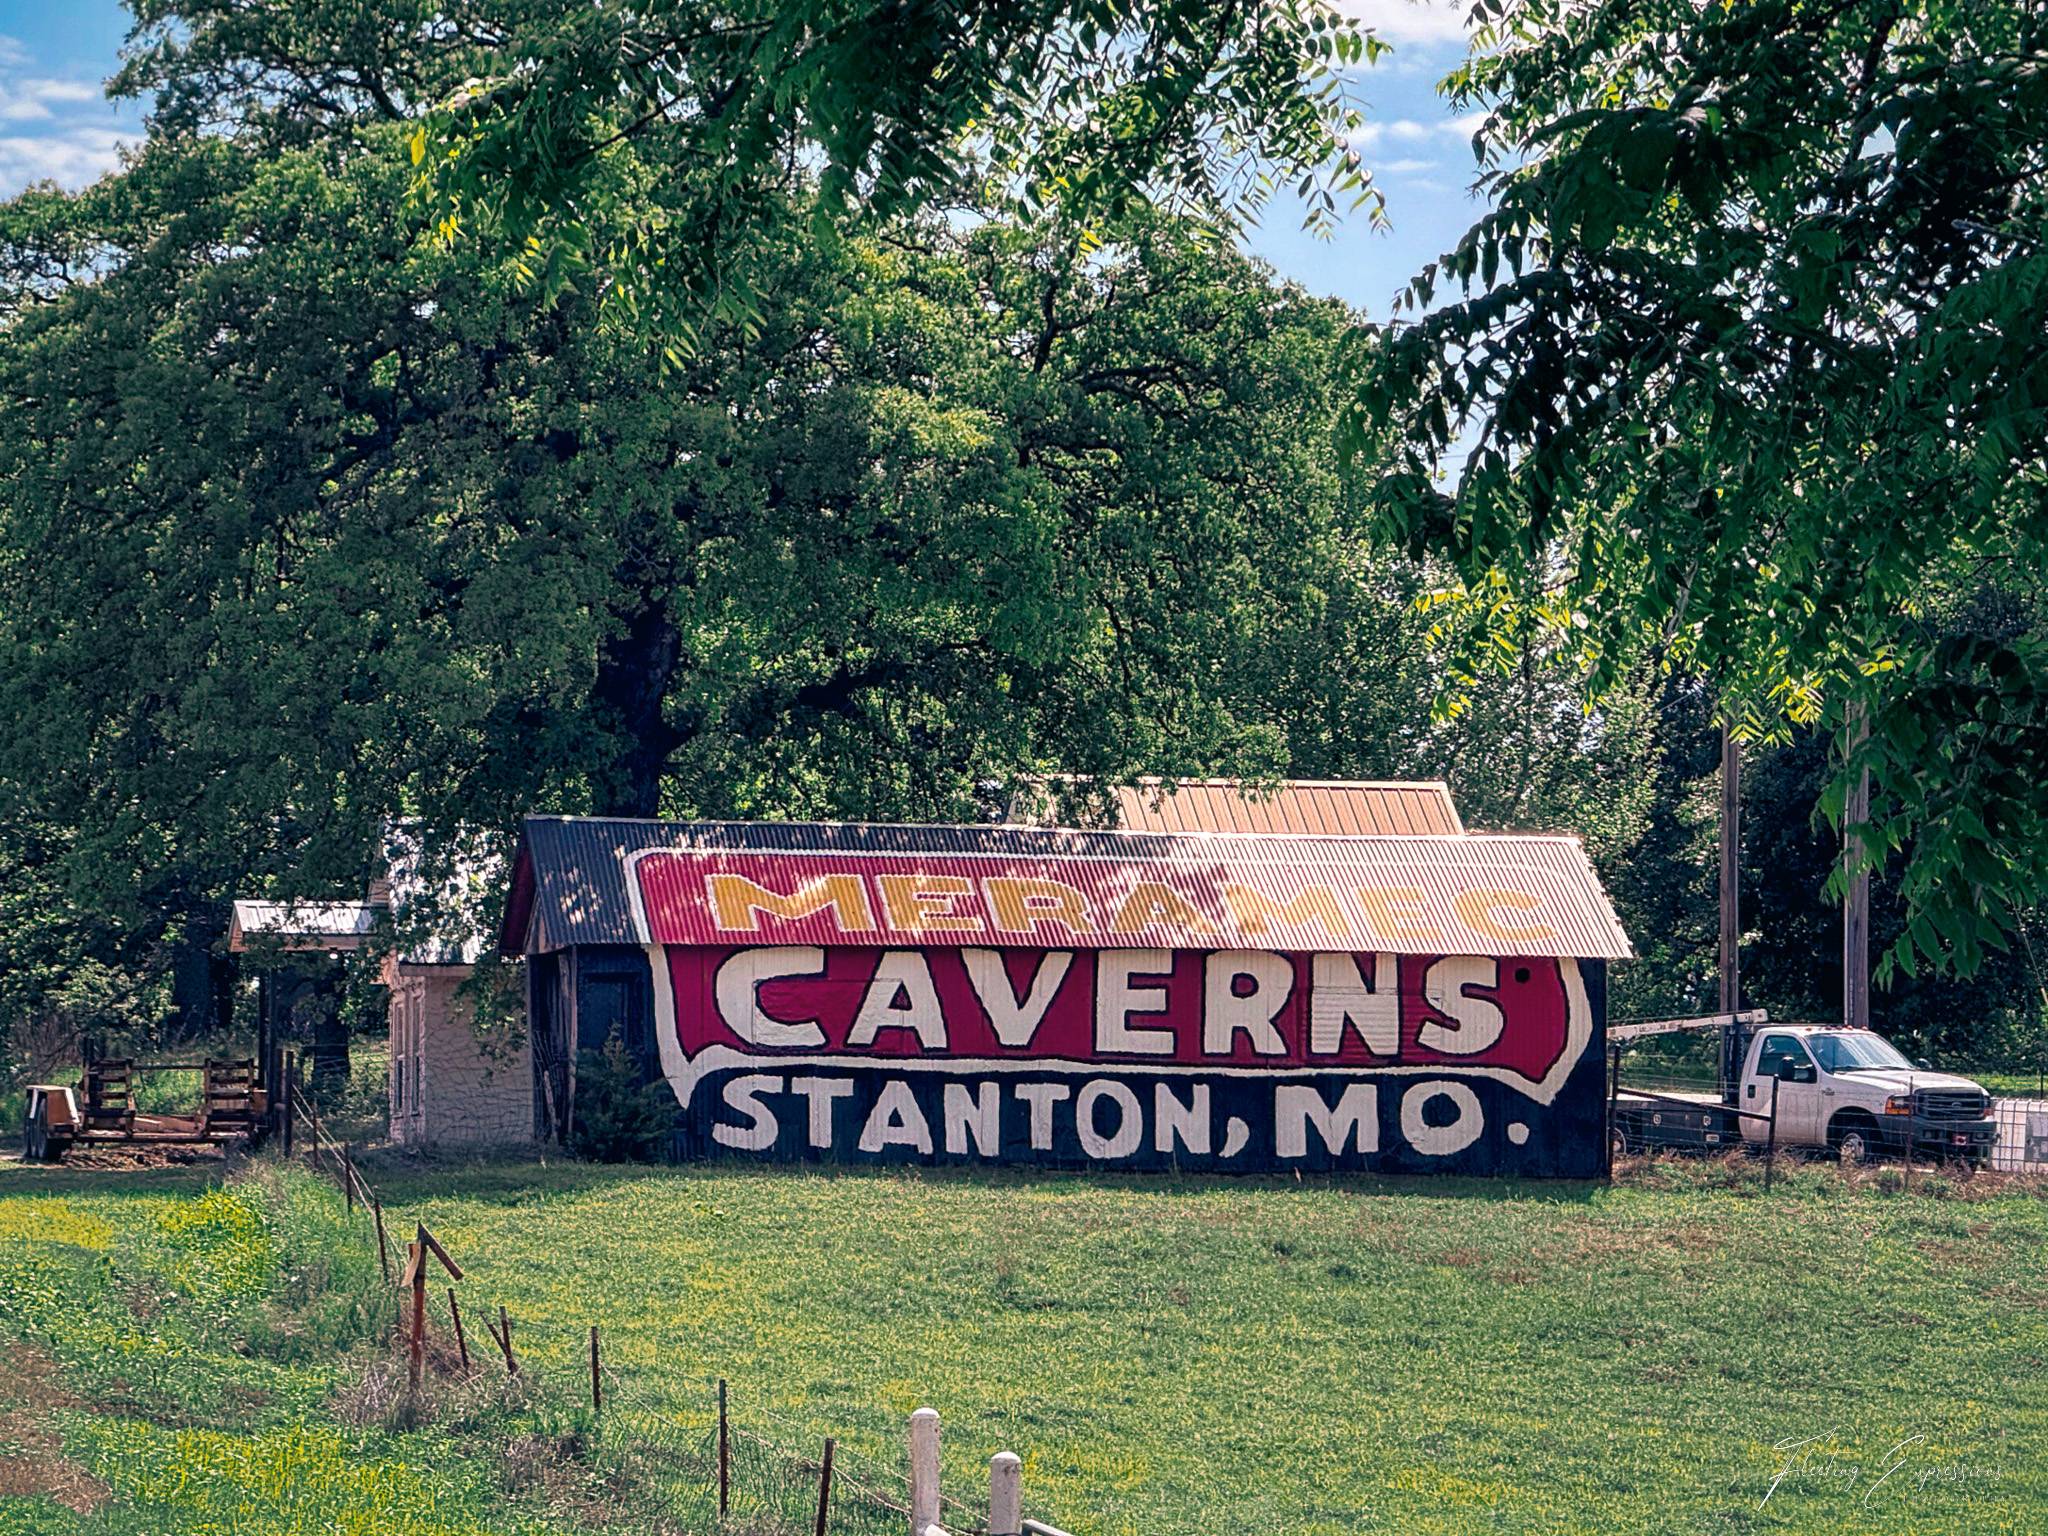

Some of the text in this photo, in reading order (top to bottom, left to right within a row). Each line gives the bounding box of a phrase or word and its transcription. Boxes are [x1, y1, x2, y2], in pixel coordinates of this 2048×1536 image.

[704, 872, 1557, 942] MERAMEC
[715, 946, 1504, 1055] CAVERNS
[712, 1075, 1530, 1158] STANTON, MO.
